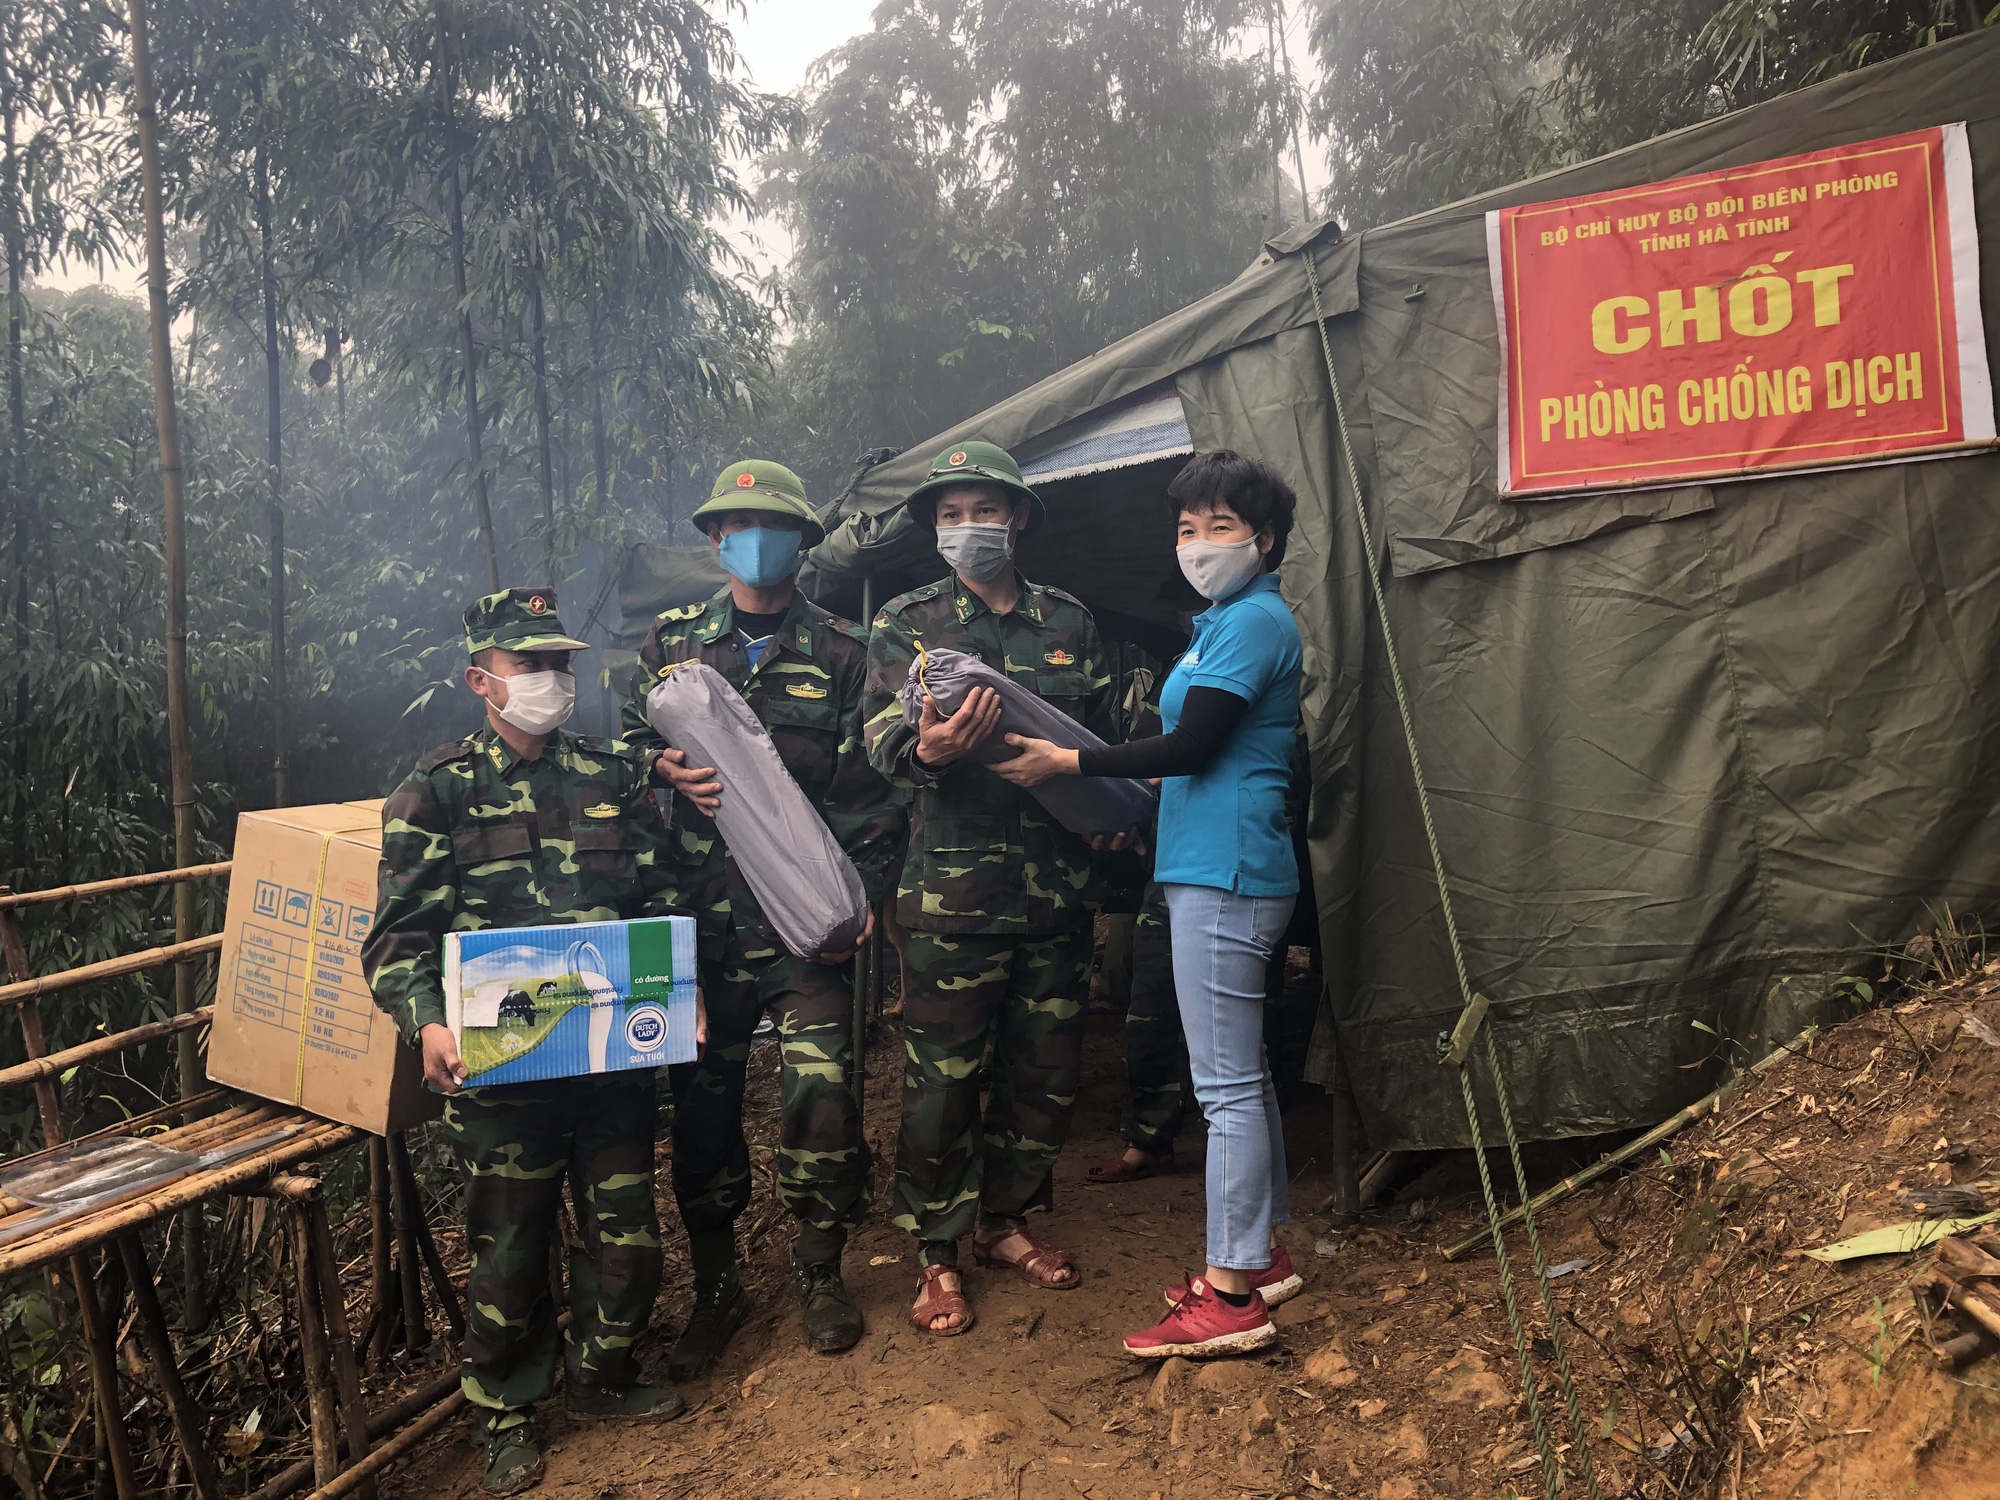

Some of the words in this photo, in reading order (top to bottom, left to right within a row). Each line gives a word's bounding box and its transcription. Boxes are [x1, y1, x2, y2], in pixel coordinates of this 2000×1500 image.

[1541, 226, 1568, 247] BỘ
[1575, 216, 1611, 239] CHỈ
[1618, 212, 1661, 233] HUY
[1668, 203, 1698, 225] BỘ
[1705, 196, 1744, 217] ĐỘI
[1752, 187, 1807, 211] BIÊN
[1815, 171, 1898, 199] PHÒNG
[1639, 232, 1691, 254] TỈNH
[1698, 223, 1729, 245] HÀ
[1736, 216, 1790, 239] TĨNH
[1591, 251, 1854, 354] CHỐT
[1540, 381, 1666, 442] PHÒNG
[1678, 356, 1812, 426] CHỐNG
[1825, 352, 1923, 417] DỊCH
[634, 975, 644, 984] có
[314, 1006, 324, 1016] 12
[325, 1010, 335, 1020] KG
[323, 1027, 333, 1038] KG
[635, 1022, 658, 1032] DUTCH
[638, 1030, 655, 1038] LADY
